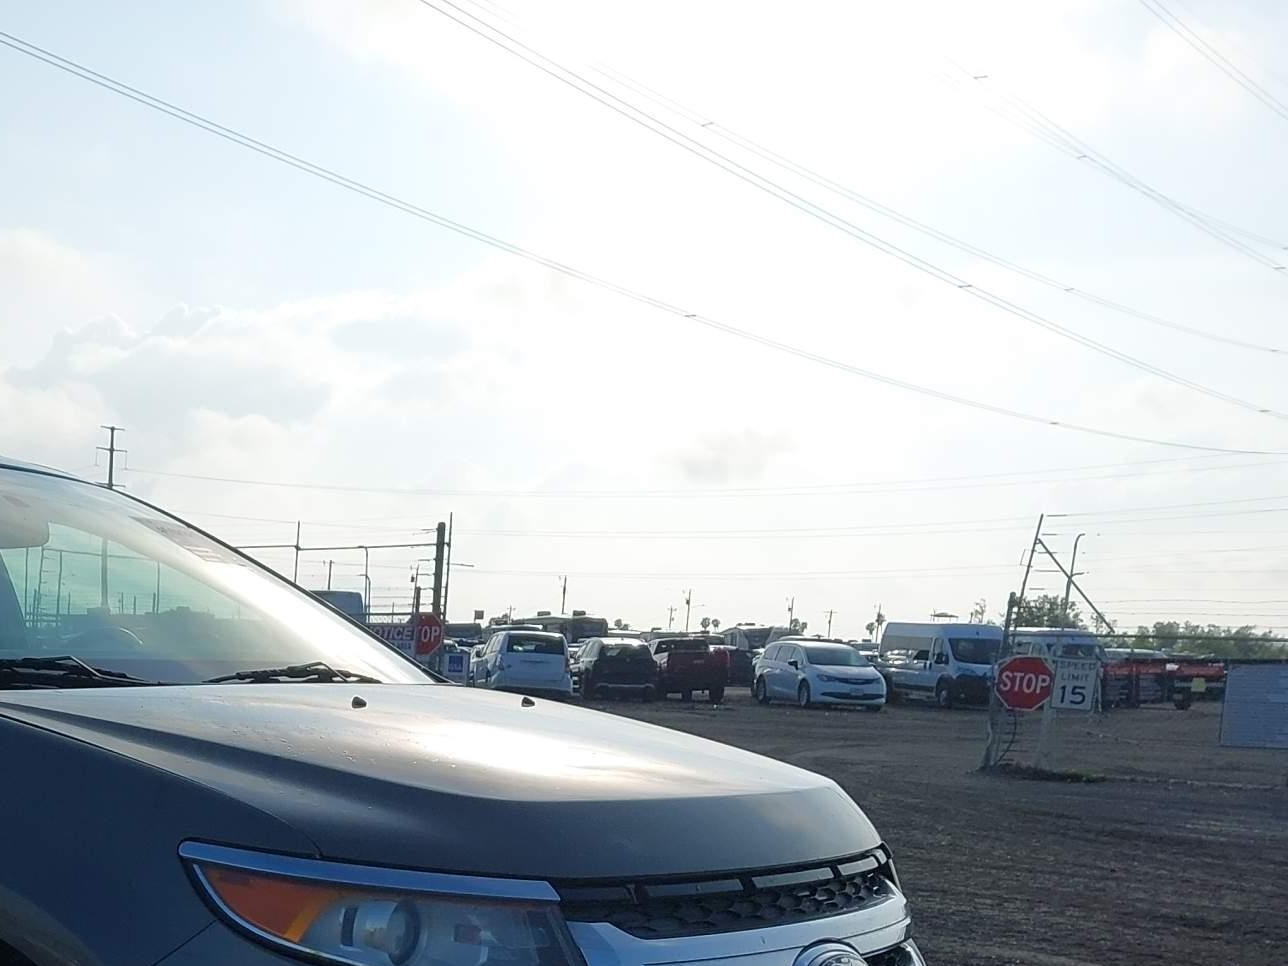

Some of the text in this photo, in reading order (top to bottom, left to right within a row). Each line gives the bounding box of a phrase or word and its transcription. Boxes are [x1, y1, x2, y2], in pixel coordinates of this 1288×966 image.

[370, 626, 413, 640] OTICE
[419, 625, 440, 642] OP
[1060, 661, 1097, 670] SPEED
[1000, 670, 1050, 694] STOP
[1061, 672, 1090, 681] LIMIT
[1060, 685, 1086, 705] 15
